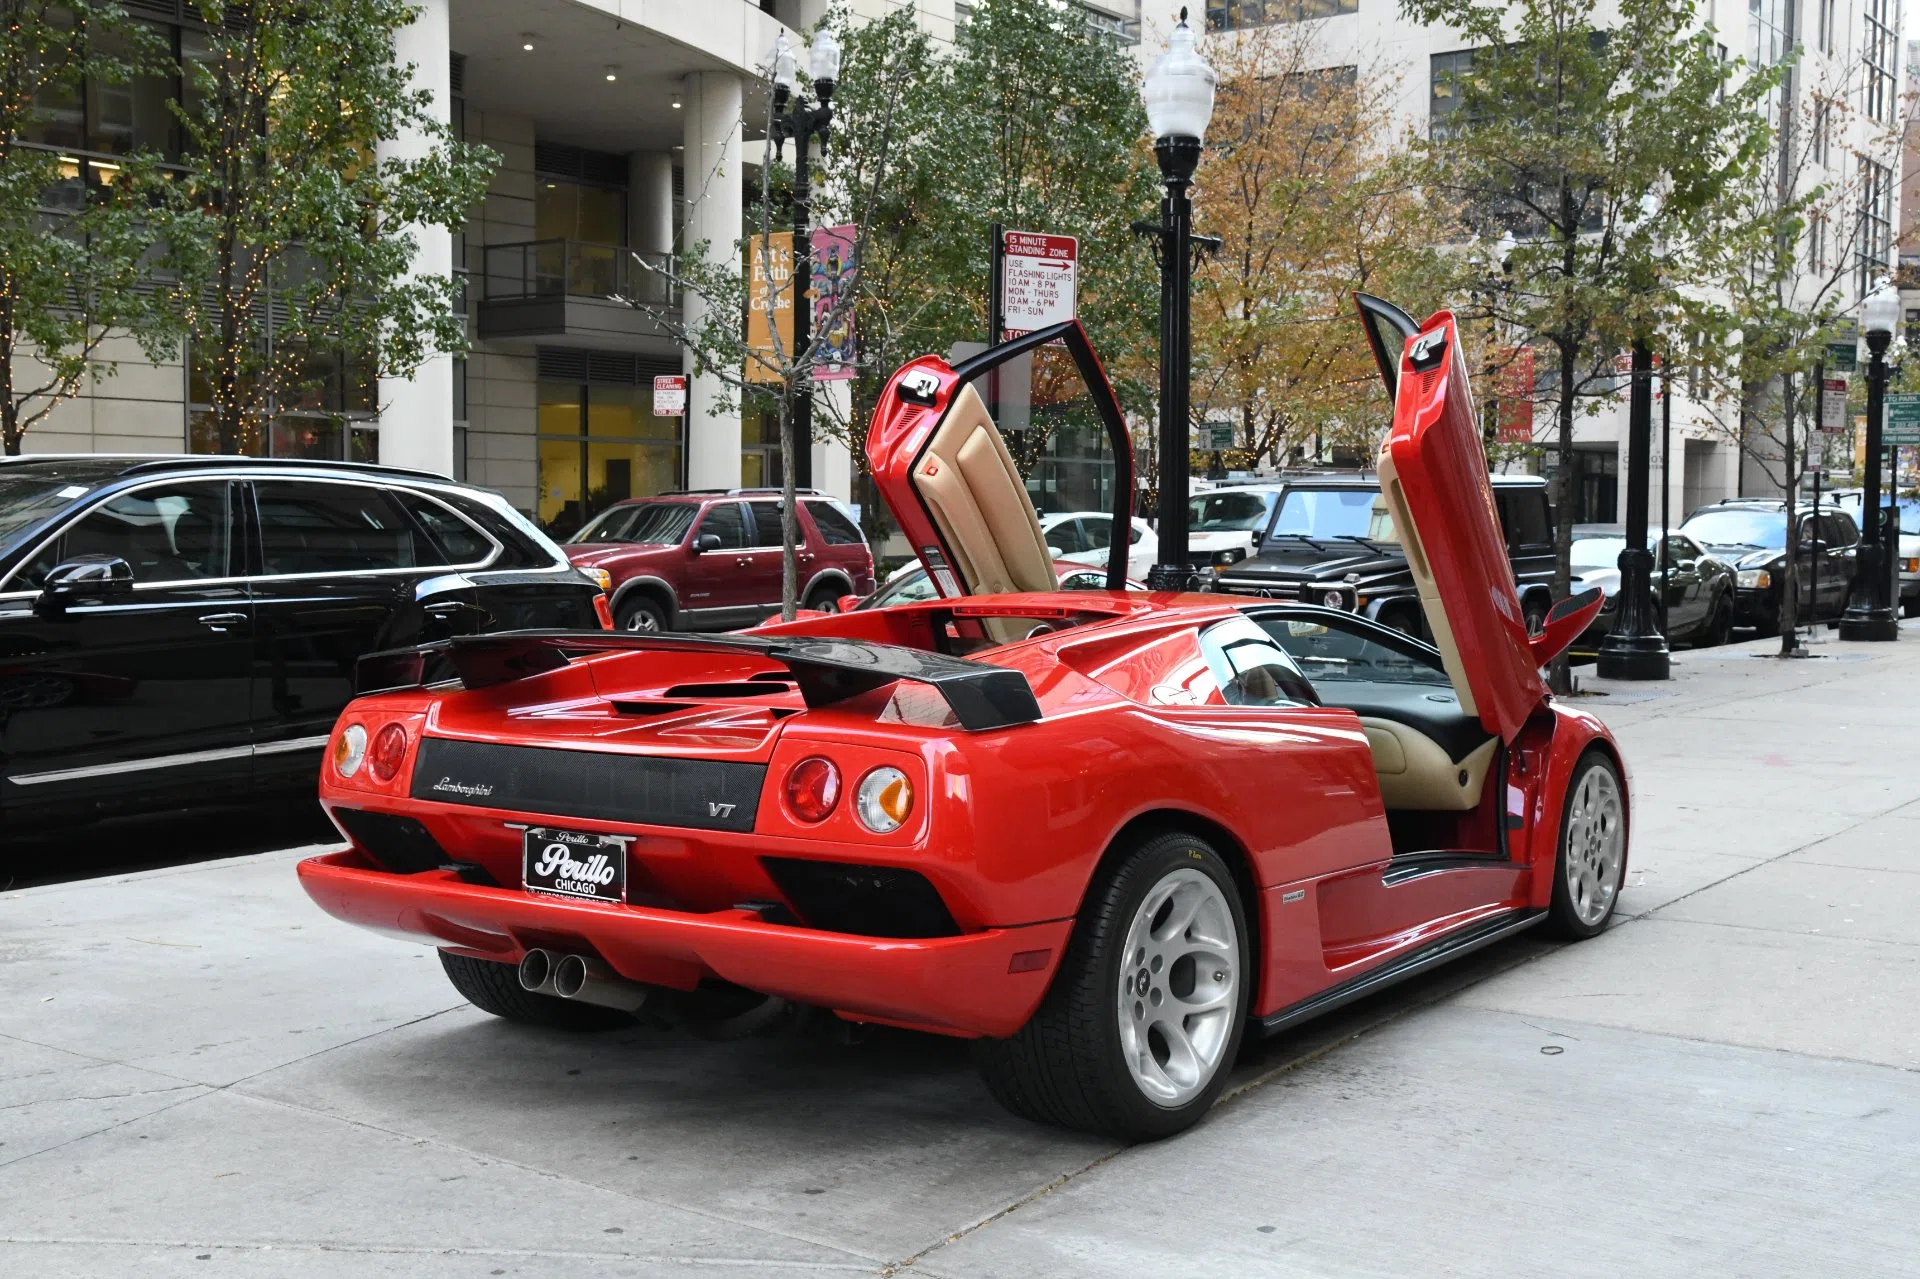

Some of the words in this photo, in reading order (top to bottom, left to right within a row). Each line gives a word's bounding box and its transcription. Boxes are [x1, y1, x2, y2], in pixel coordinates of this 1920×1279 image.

[1009, 235, 1017, 244] 15
[1019, 236, 1047, 247] MINUTE
[753, 249, 777, 264] At
[1009, 244, 1046, 256] STANDING
[1049, 248, 1069, 258] ZONE
[1009, 260, 1024, 268] USE
[753, 263, 789, 282] Fith
[1008, 269, 1046, 280] FLASHING
[1046, 271, 1072, 282] LIGHTS
[1018, 279, 1030, 287] AM
[1044, 281, 1056, 289] PM
[1008, 287, 1025, 296] MON
[1033, 288, 1060, 299] THURS
[751, 296, 791, 310] Crhe
[1017, 297, 1029, 305] AM
[1043, 299, 1055, 308] PM
[1008, 305, 1021, 314] FRI
[1027, 306, 1044, 316] SUN
[433, 776, 493, 797] Lamborghini
[709, 802, 736, 818] VT
[555, 831, 589, 845] Perillo
[534, 843, 615, 886] Perillo
[555, 878, 596, 895] CHICAGO
